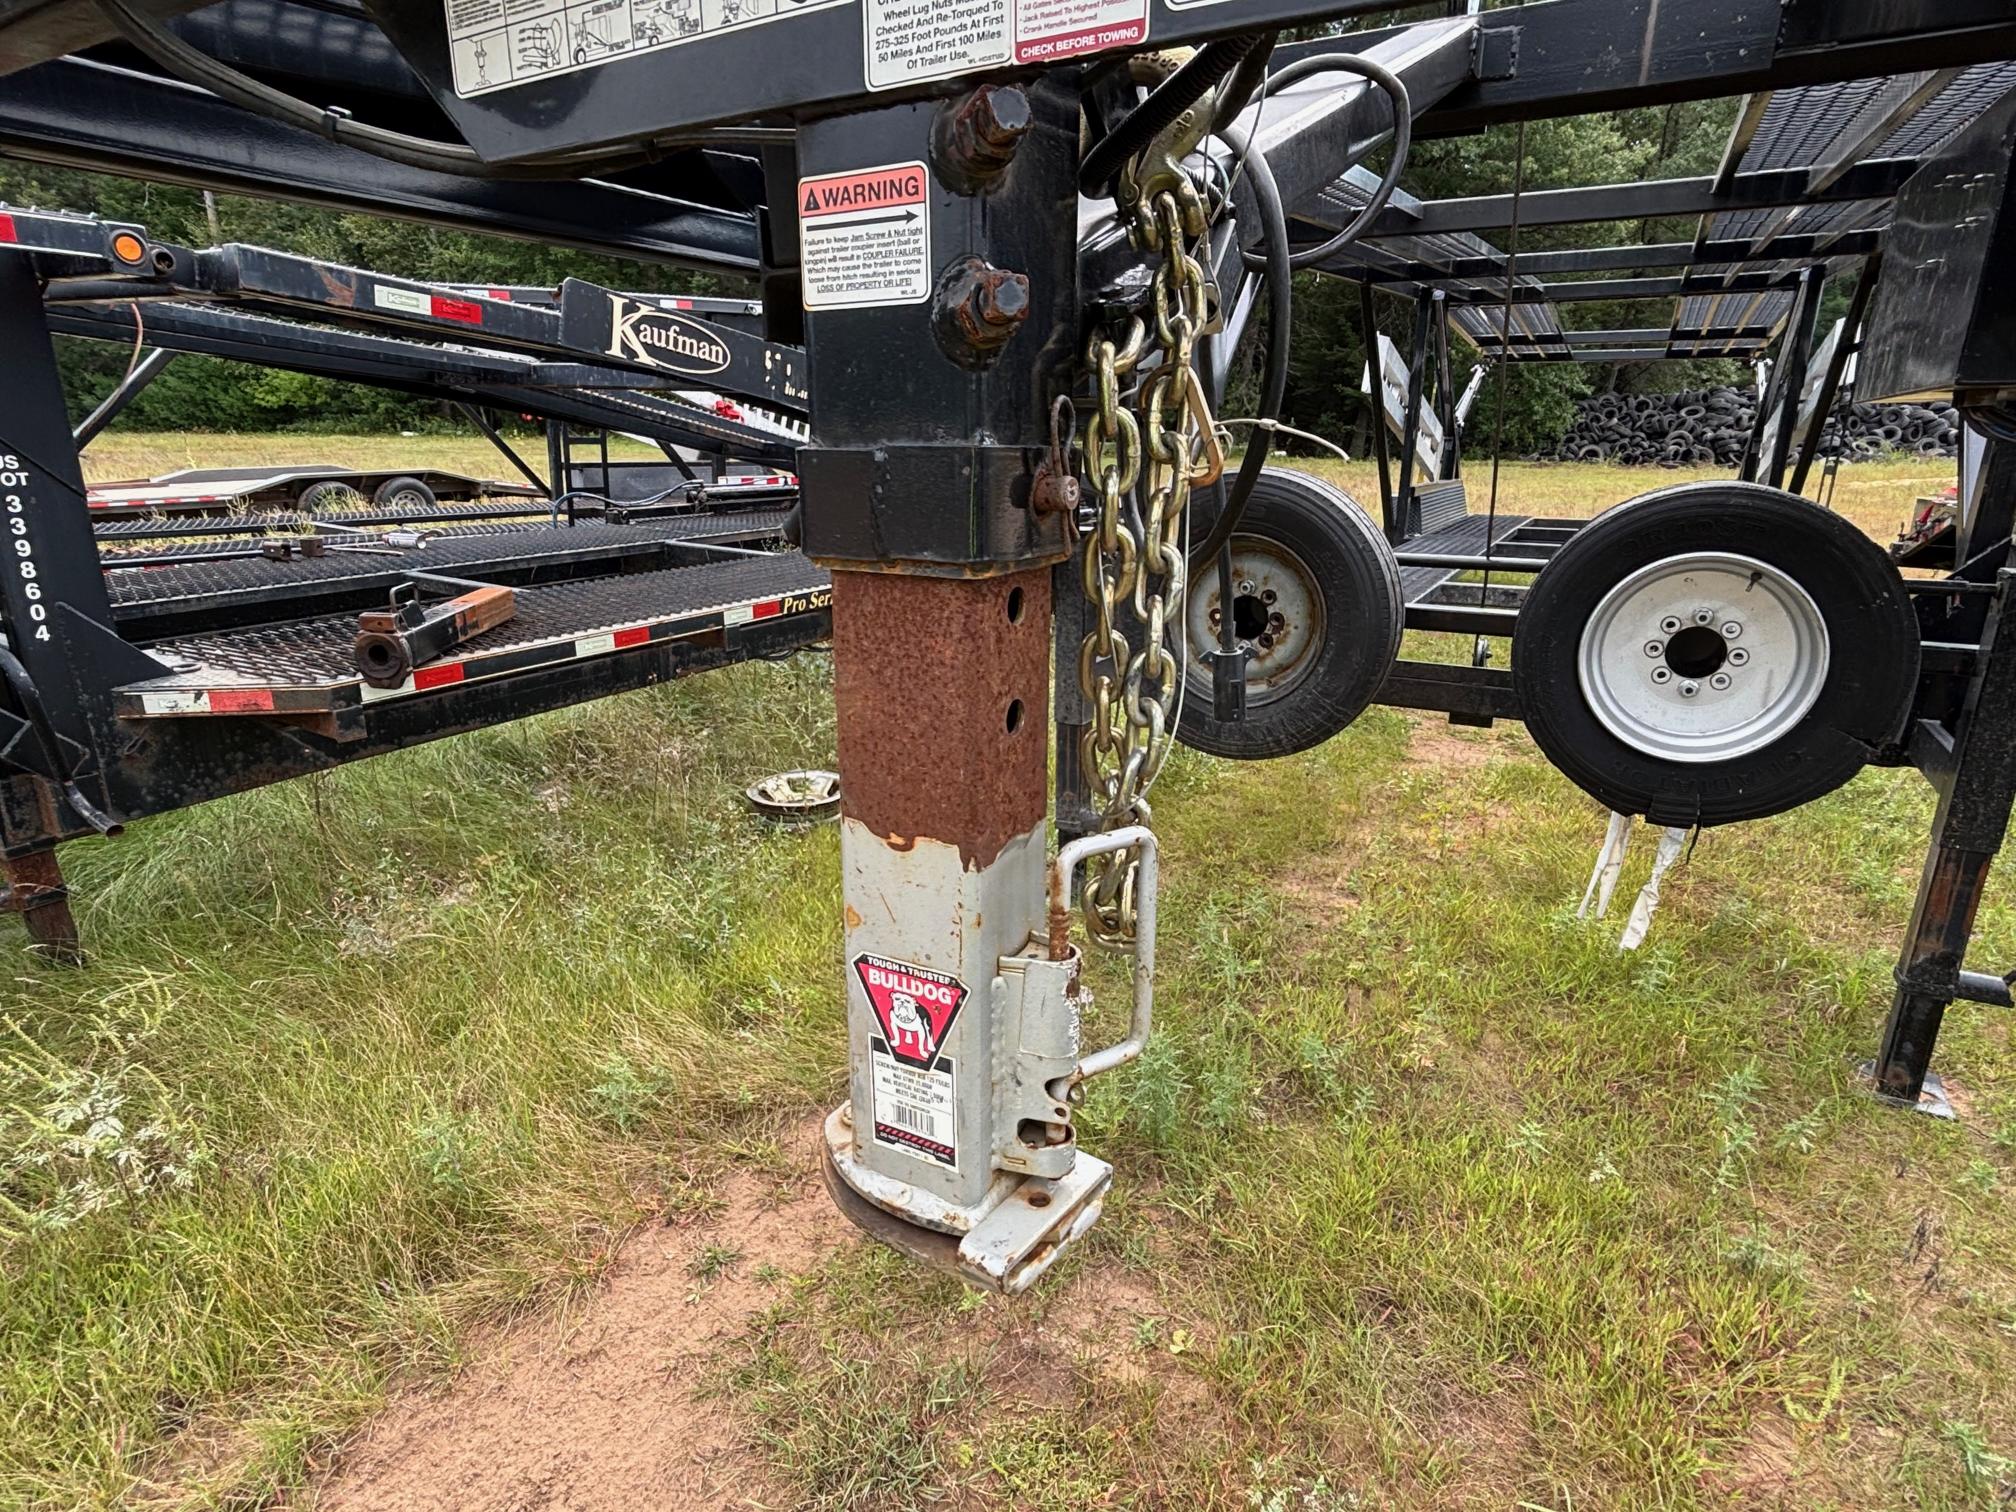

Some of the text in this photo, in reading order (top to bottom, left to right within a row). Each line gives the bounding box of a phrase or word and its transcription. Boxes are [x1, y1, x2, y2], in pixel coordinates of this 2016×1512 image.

[876, 0, 1003, 36] Checked And Re-Torqued To
[883, 6, 910, 21] Wheel
[912, 4, 929, 15] Lug
[932, 0, 952, 10] Nuts
[1023, 14, 1037, 22] Jack
[1074, 1, 1099, 12] Highest
[876, 14, 1004, 50] 275-325 Foot Pounds At First
[1023, 24, 1041, 33] Crank
[1069, 12, 1097, 24] Secured
[878, 30, 1001, 63] 50 Miles And First 100 Miles
[1021, 26, 1138, 57] CHECK BEFORE TOWING
[907, 50, 969, 69] Of Trailer Use.
[822, 176, 919, 207] WARNING
[907, 227, 922, 236] tight
[808, 247, 829, 256] against
[831, 245, 849, 253] trailer
[851, 243, 875, 251] coupler
[877, 240, 895, 248] insert
[863, 249, 893, 259] COUPLER
[807, 266, 826, 274] Which
[874, 260, 892, 268] trailer
[859, 271, 886, 279] resulting
[817, 284, 833, 293] LOSS
[835, 283, 844, 291] OF
[846, 280, 881, 290] PROPERTY
[883, 279, 893, 287] OR
[605, 294, 725, 367] Kaufman
[5, 495, 51, 642] 3398604
[783, 597, 806, 614] Pro
[867, 957, 899, 972] TOUGH
[868, 968, 952, 1005] BULLDOG
